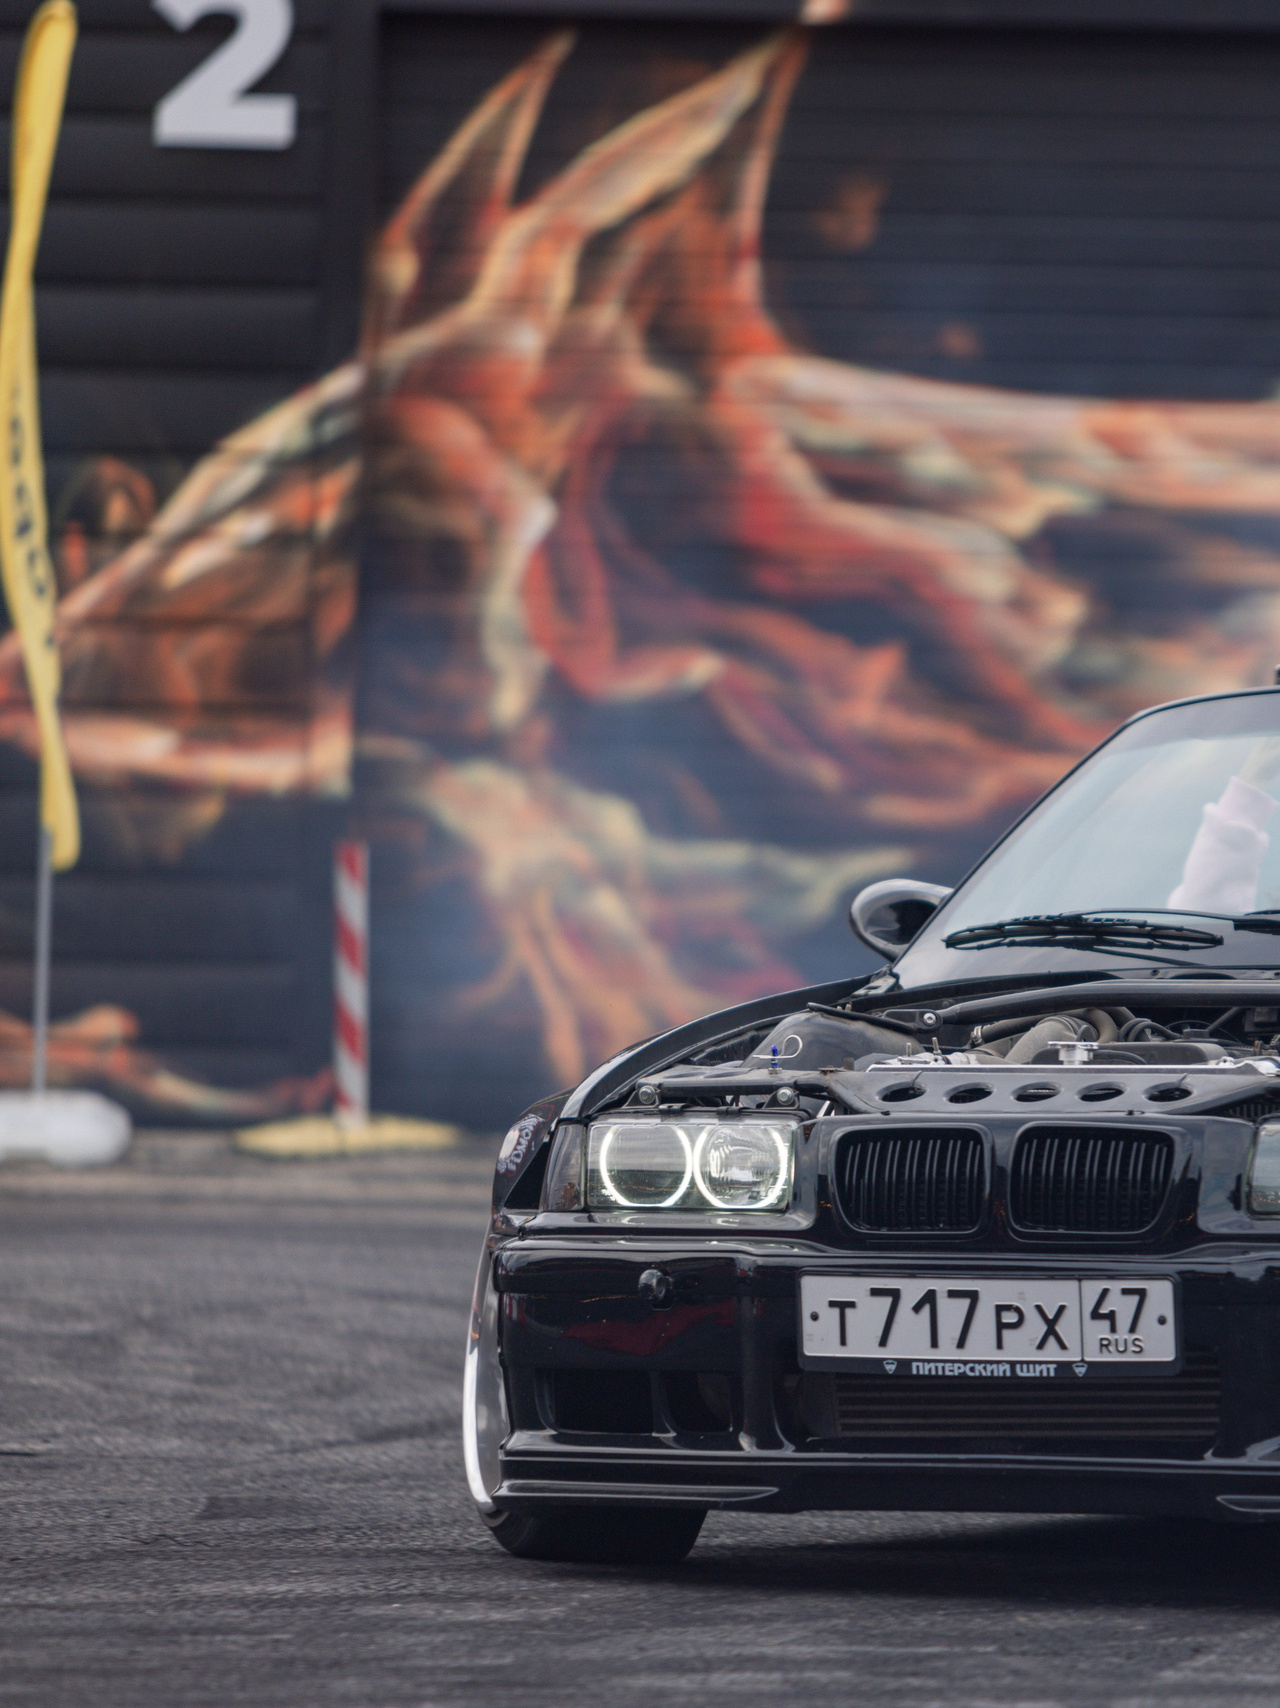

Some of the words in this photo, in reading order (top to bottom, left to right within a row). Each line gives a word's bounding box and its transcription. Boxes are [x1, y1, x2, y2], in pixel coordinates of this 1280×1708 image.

[152, 0, 298, 150] 2
[1089, 1286, 1148, 1334] 47
[1098, 1336, 1145, 1355] RUS
[911, 1361, 1012, 1378] ПИТЕРСКИЙ
